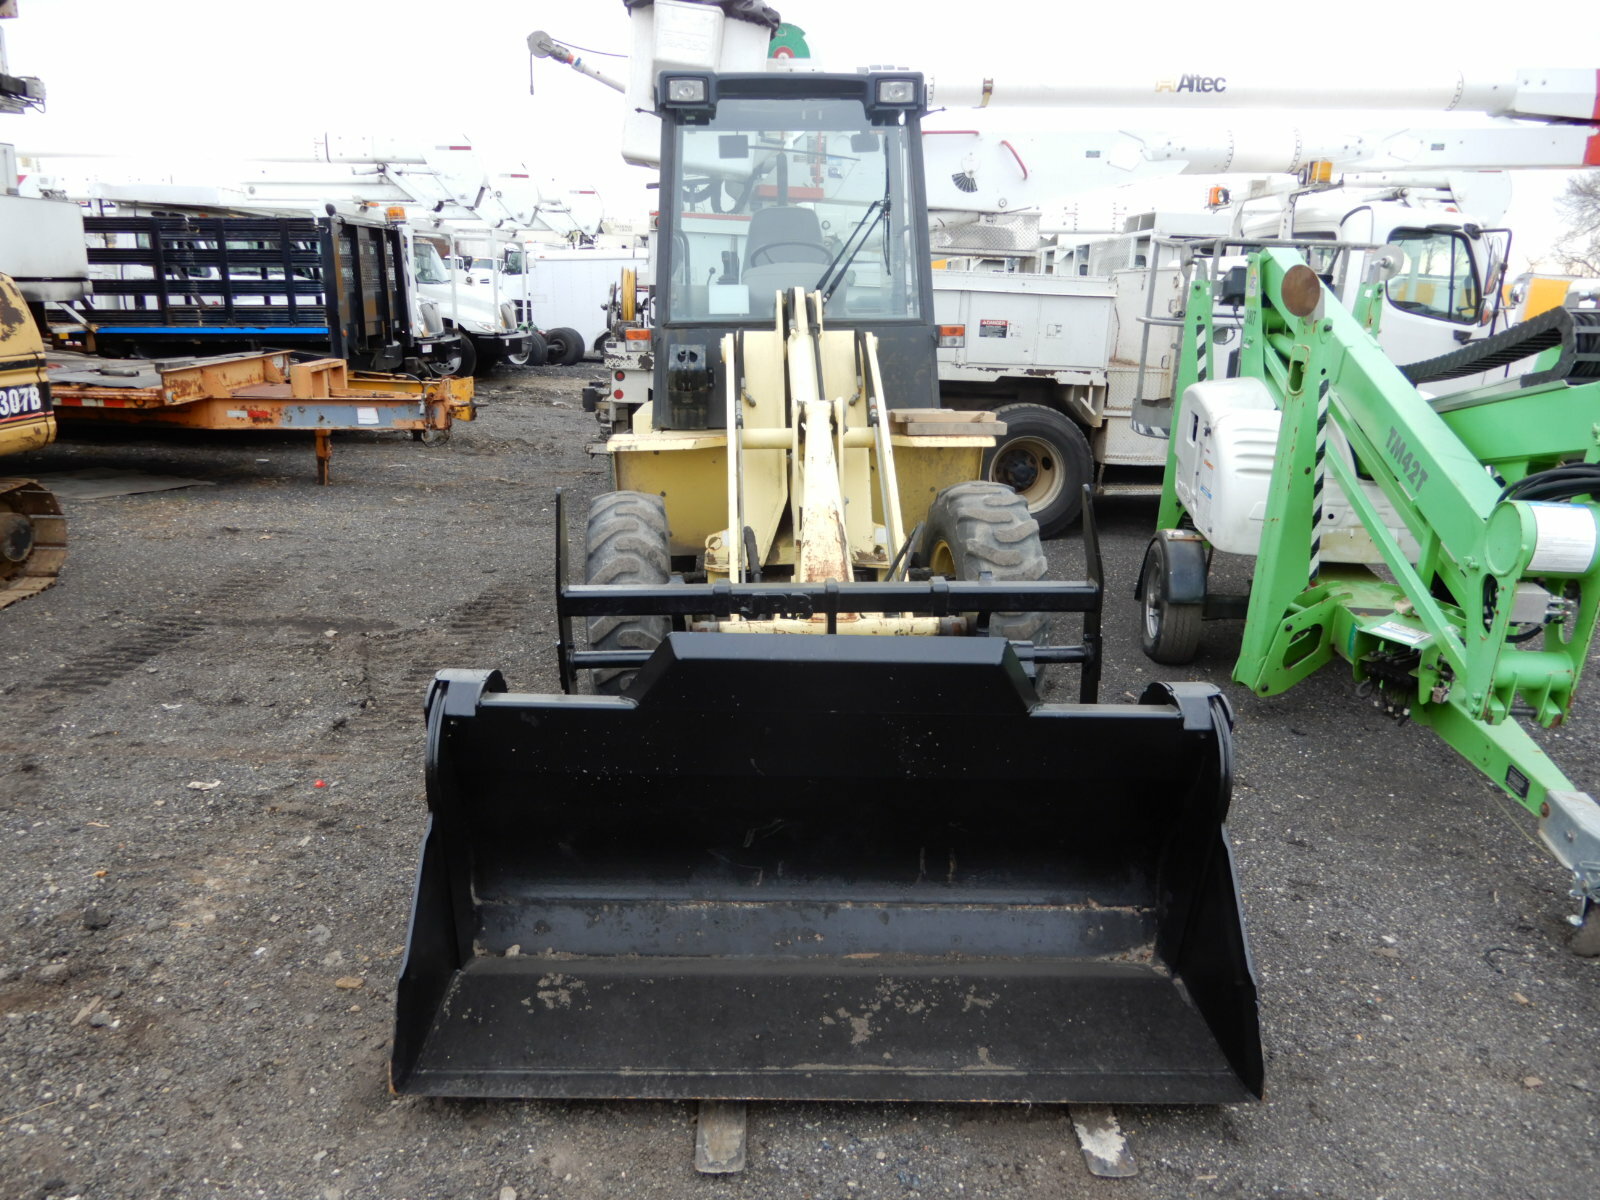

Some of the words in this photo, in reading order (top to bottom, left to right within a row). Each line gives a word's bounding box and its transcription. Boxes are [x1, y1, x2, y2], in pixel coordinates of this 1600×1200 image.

[1176, 73, 1226, 93] Altec
[0, 386, 41, 415] 307B
[1385, 425, 1429, 493] TM42T
